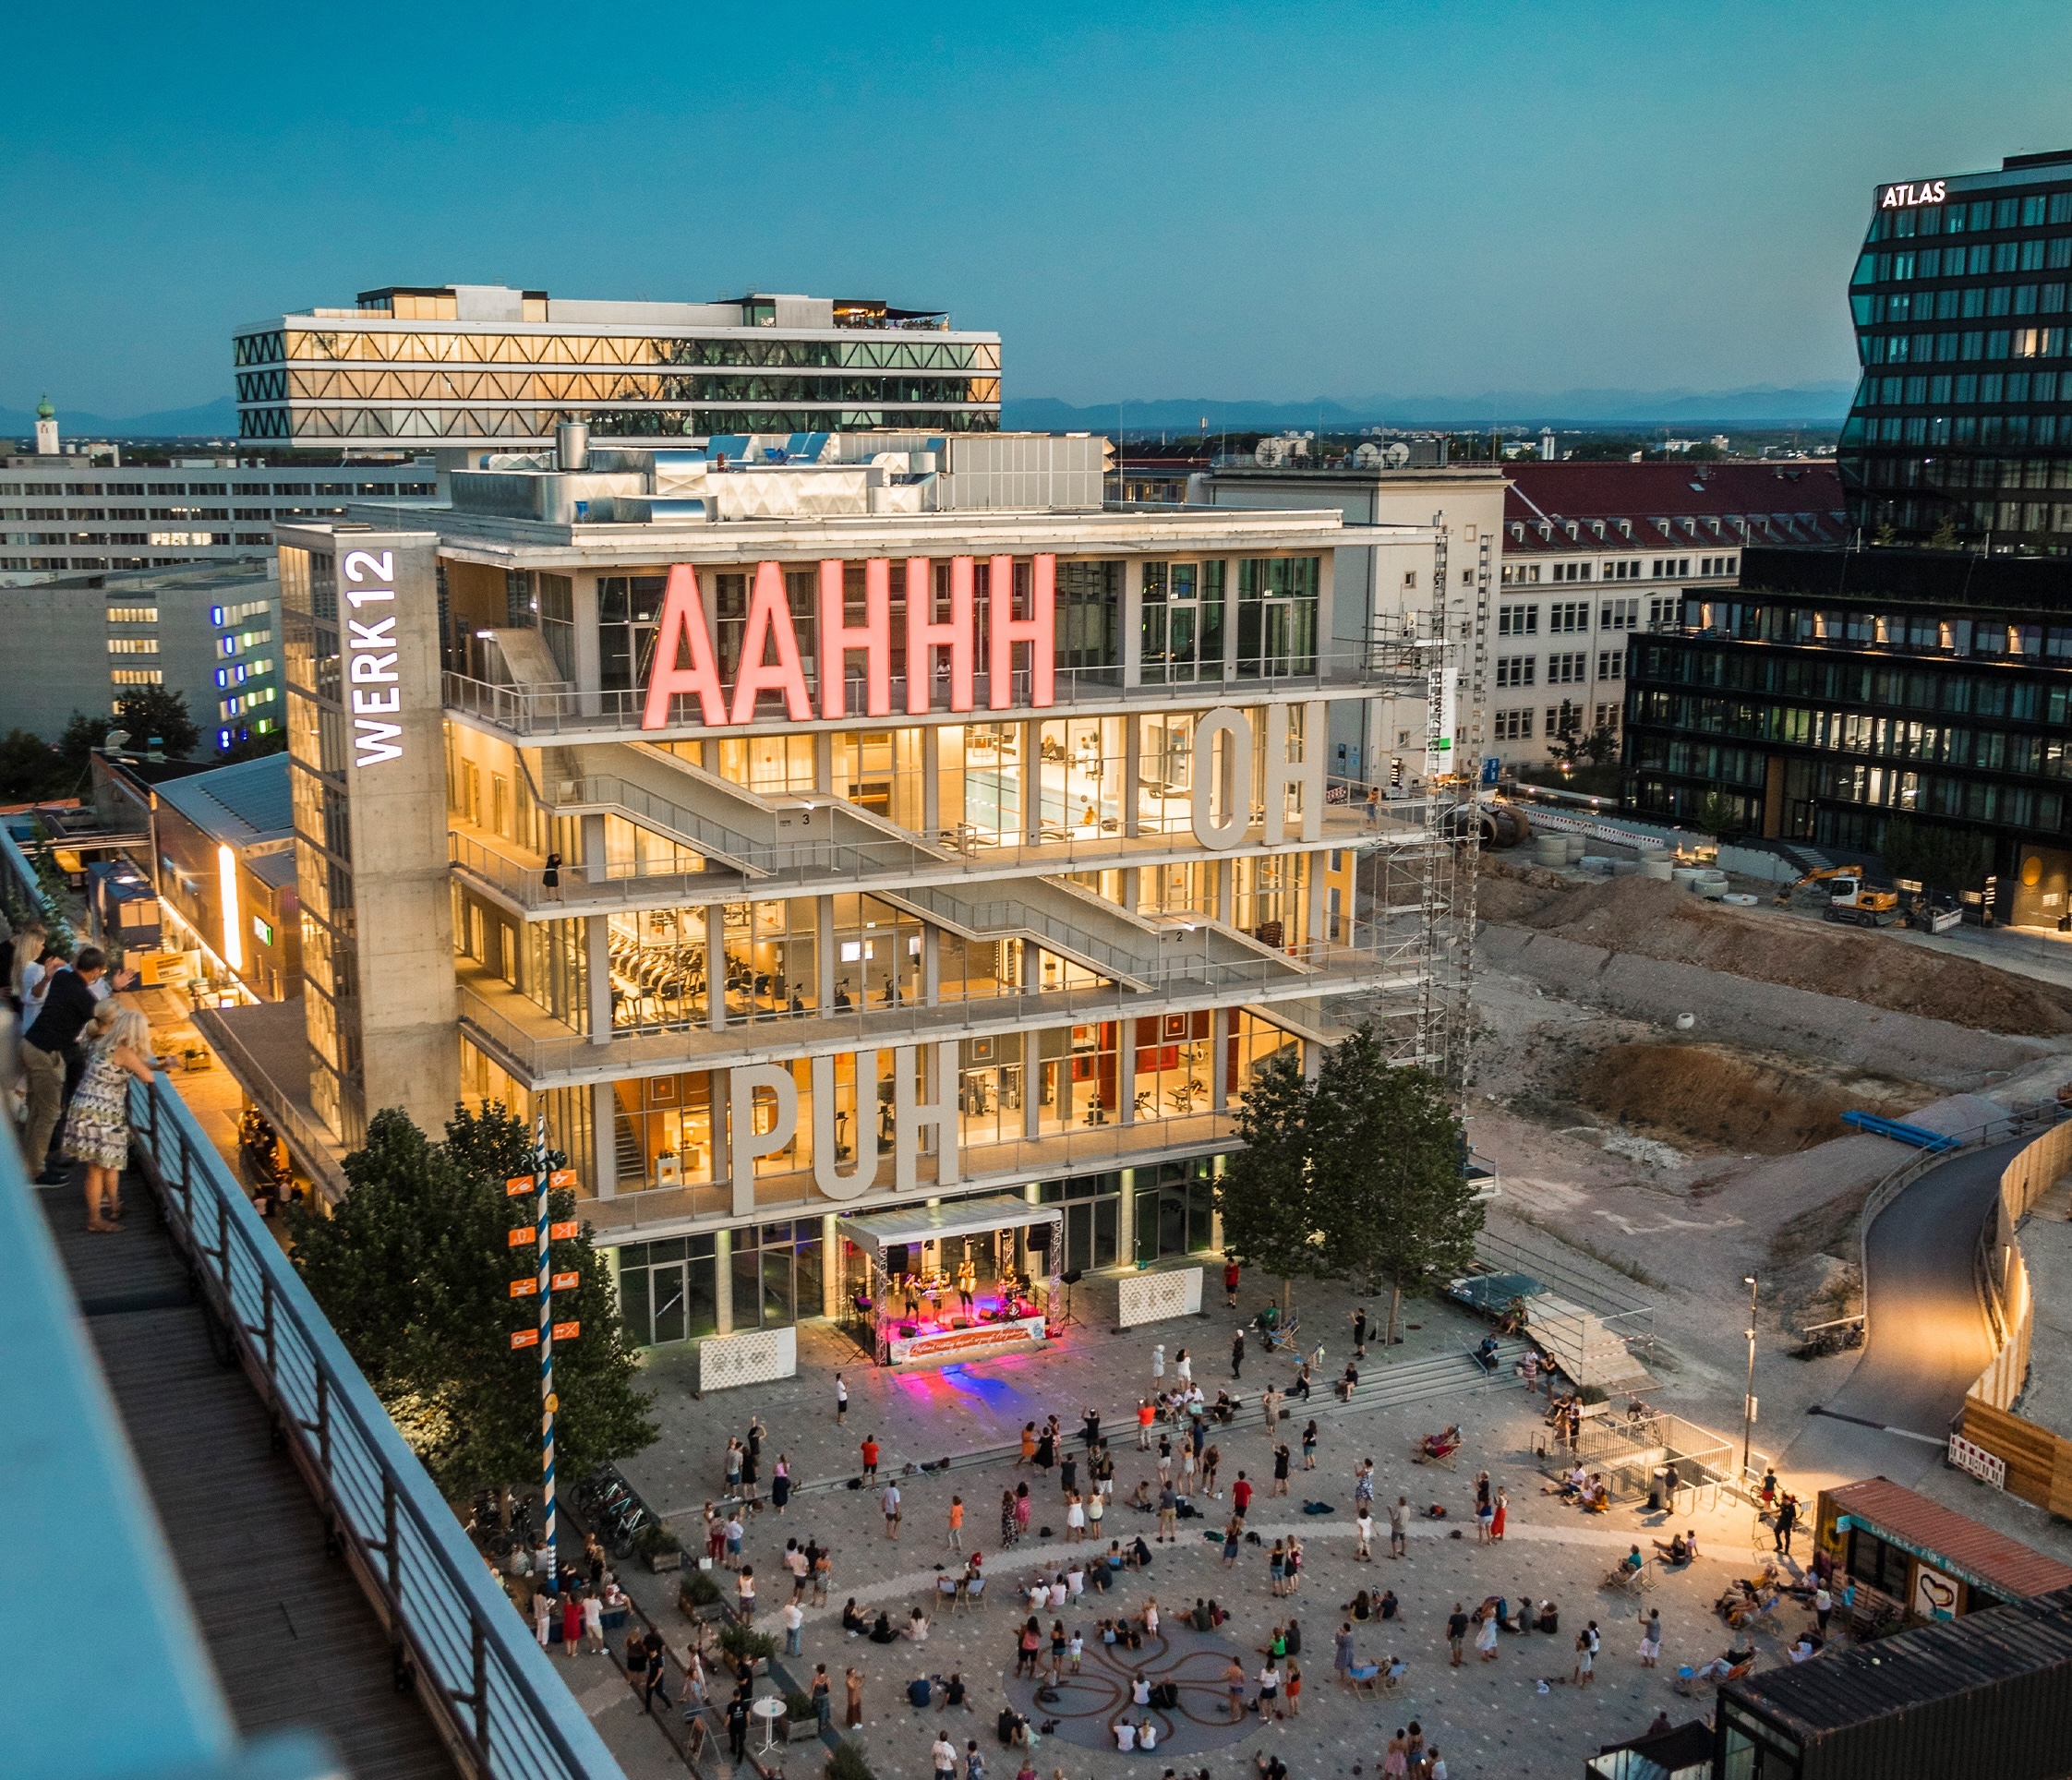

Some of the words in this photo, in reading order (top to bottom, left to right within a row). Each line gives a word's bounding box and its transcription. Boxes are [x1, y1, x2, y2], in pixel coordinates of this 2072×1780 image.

[1882, 180, 1946, 208] ATLAS
[343, 549, 403, 767] WERK12
[642, 554, 1055, 730] AAHHH
[802, 813, 810, 824] 3
[1191, 701, 1326, 850] OH
[1176, 932, 1183, 942] 2
[730, 1040, 959, 1217] PUH
